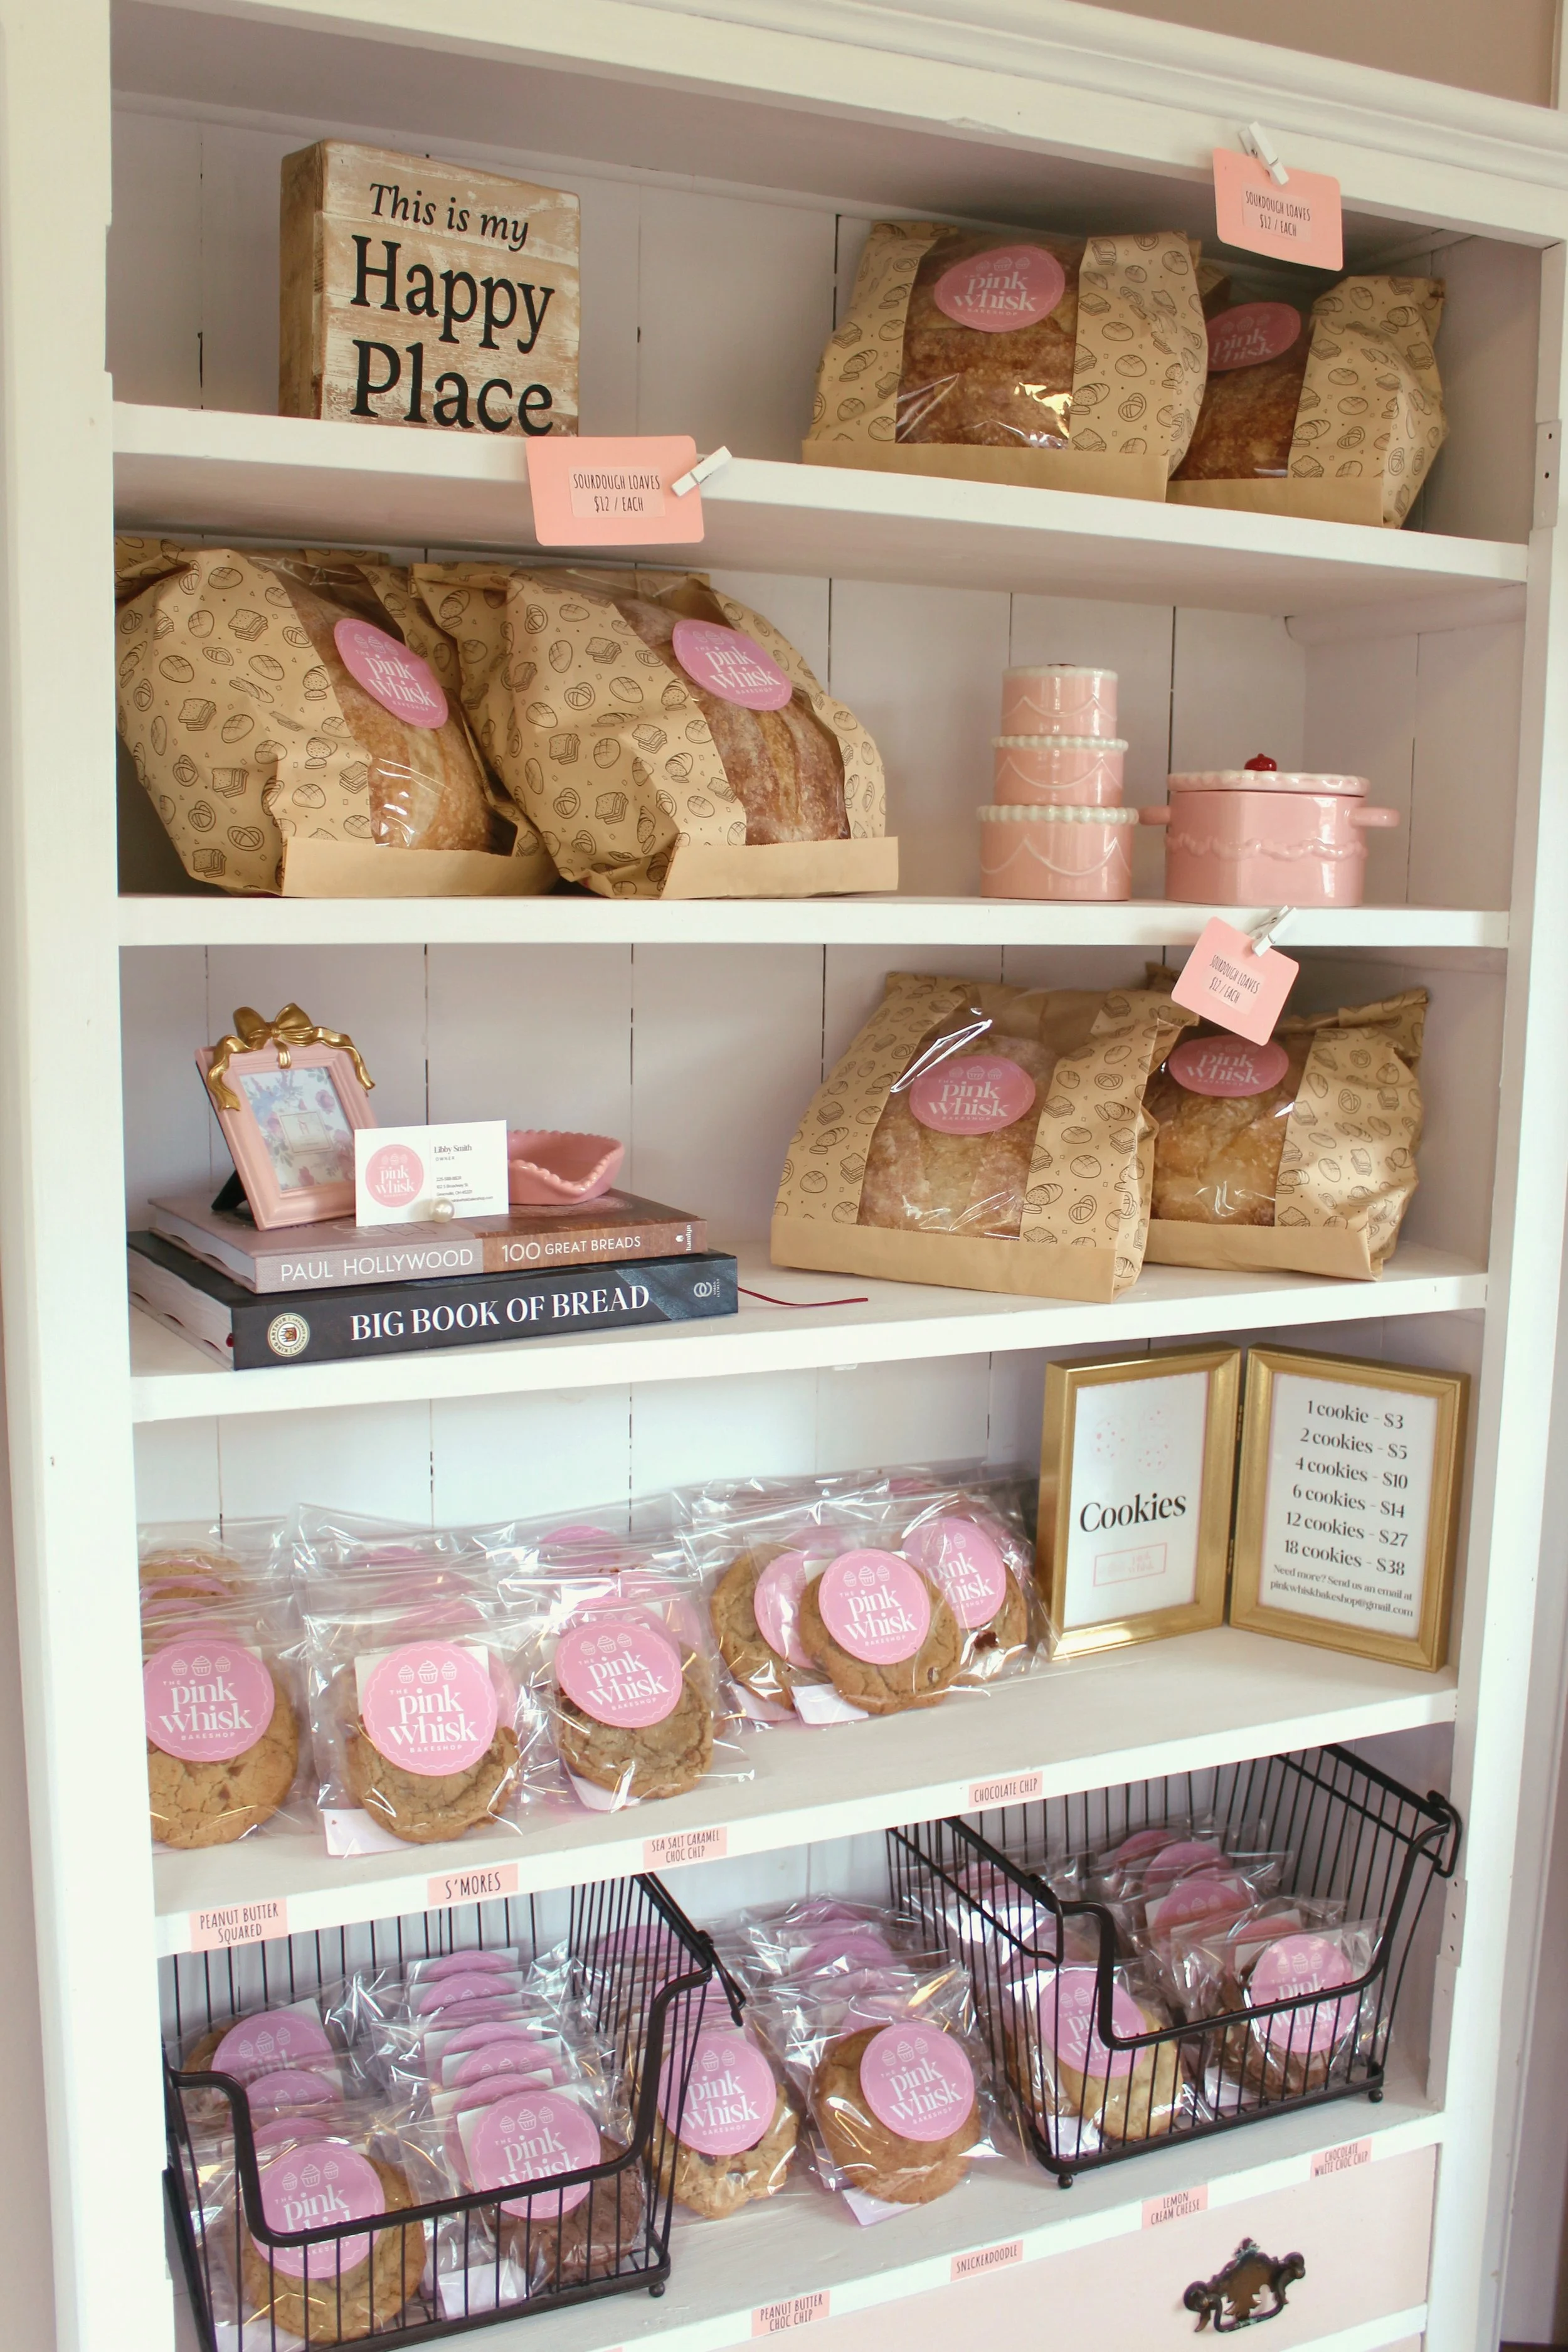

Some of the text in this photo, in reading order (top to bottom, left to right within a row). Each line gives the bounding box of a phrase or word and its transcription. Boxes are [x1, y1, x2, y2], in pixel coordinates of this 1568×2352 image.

[369, 183, 529, 253] This is my
[1246, 191, 1310, 221] SOURDOUGH LOAVES
[1260, 214, 1296, 236] $12 / EACH
[350, 234, 556, 354] Happy
[967, 272, 1028, 295] pink
[953, 289, 1037, 312] whisk
[350, 339, 554, 436] Place
[573, 474, 660, 490] SOURDOUGH LOAVES
[594, 495, 644, 513] $12 / EACH
[364, 654, 417, 682] pink
[705, 646, 756, 673] pink
[709, 665, 781, 689] whisk
[368, 676, 437, 707] whisk
[1209, 955, 1261, 994] SOURDOUGH LOAVES
[1209, 977, 1241, 1004] $12 / EACH
[1199, 1053, 1254, 1068] pink
[1187, 1065, 1262, 1084] whisk
[941, 1081, 1001, 1102] pink
[928, 1098, 1010, 1117] whisk
[434, 1146, 452, 1155] Libby
[374, 1179, 415, 1194] whisk
[380, 1165, 408, 1184] pink
[502, 1236, 641, 1263] 100 GREAT BREADS
[280, 1248, 474, 1282] PAUL HOLLYWOOD
[350, 1285, 650, 1341] BIG BOOK OF BREAD
[272, 1318, 286, 1340] ARTHUR
[1308, 1400, 1313, 1414] 1
[1316, 1405, 1369, 1423] cookie
[1384, 1413, 1403, 1429] $3
[1300, 1428, 1310, 1442] 2
[1313, 1433, 1373, 1454] cookies
[1388, 1443, 1407, 1459] $5
[1295, 1457, 1303, 1470] 4
[1308, 1461, 1368, 1482] cookies
[1382, 1471, 1408, 1490] $10
[1080, 1493, 1186, 1532] Cookies
[1293, 1483, 1301, 1499] 6
[1305, 1490, 1366, 1510] cookies
[1380, 1500, 1405, 1518] $14
[1286, 1512, 1301, 1527] 12
[1305, 1518, 1364, 1540] cookies
[1379, 1529, 1408, 1547] $27
[1285, 1540, 1298, 1555] 18
[1301, 1547, 1362, 1568] cookies
[1376, 1557, 1405, 1576] $38
[946, 1573, 995, 1603] hisk
[1273, 1564, 1412, 1601] Need more? Send us an email at
[847, 1585, 901, 1622] pink
[1270, 1579, 1413, 1617] pinkwhiskbakeshop@gmail.com
[844, 1608, 917, 1640] whisk
[588, 1650, 650, 1688] pink
[171, 1676, 238, 1714] pink
[586, 1670, 670, 1705] whisk
[398, 1684, 464, 1724] pink
[611, 1697, 657, 1711] BAKESHOP
[159, 1702, 252, 1734] whisk
[387, 1713, 479, 1745] whisk
[181, 1732, 236, 1740] BAKESHOP
[410, 1744, 462, 1753] BAKESHOP
[974, 1778, 1037, 1803] CHOCOLATE CHIP
[652, 1830, 720, 1852] SEA SALT CARAMEL
[666, 1845, 705, 1863] CHOC CHIP
[445, 1872, 501, 1899] S'MORES
[200, 1903, 278, 1929] PEANUT BUTTER
[218, 1924, 262, 1944] SQUARED
[687, 2070, 744, 2110] pink
[889, 2057, 943, 2101] pink
[682, 2095, 760, 2130] whisk
[889, 2079, 963, 2120] whisk
[494, 2137, 511, 2146] THE
[503, 2127, 566, 2172] pink
[1325, 2143, 1358, 2163] CHOCOLATE
[1336, 2156, 1351, 2170] CHOC
[1354, 2151, 1368, 2165] CHIP
[275, 2196, 293, 2204] THE
[283, 2184, 349, 2230] pink
[1151, 2199, 1199, 2225] CREAM CHEESE
[1163, 2191, 1189, 2209] LEMON
[956, 2245, 1017, 2274] SNICKERDOODLE
[760, 2294, 823, 2321] PEANUT BUTTER
[770, 2309, 813, 2331] CHOC CHIP
